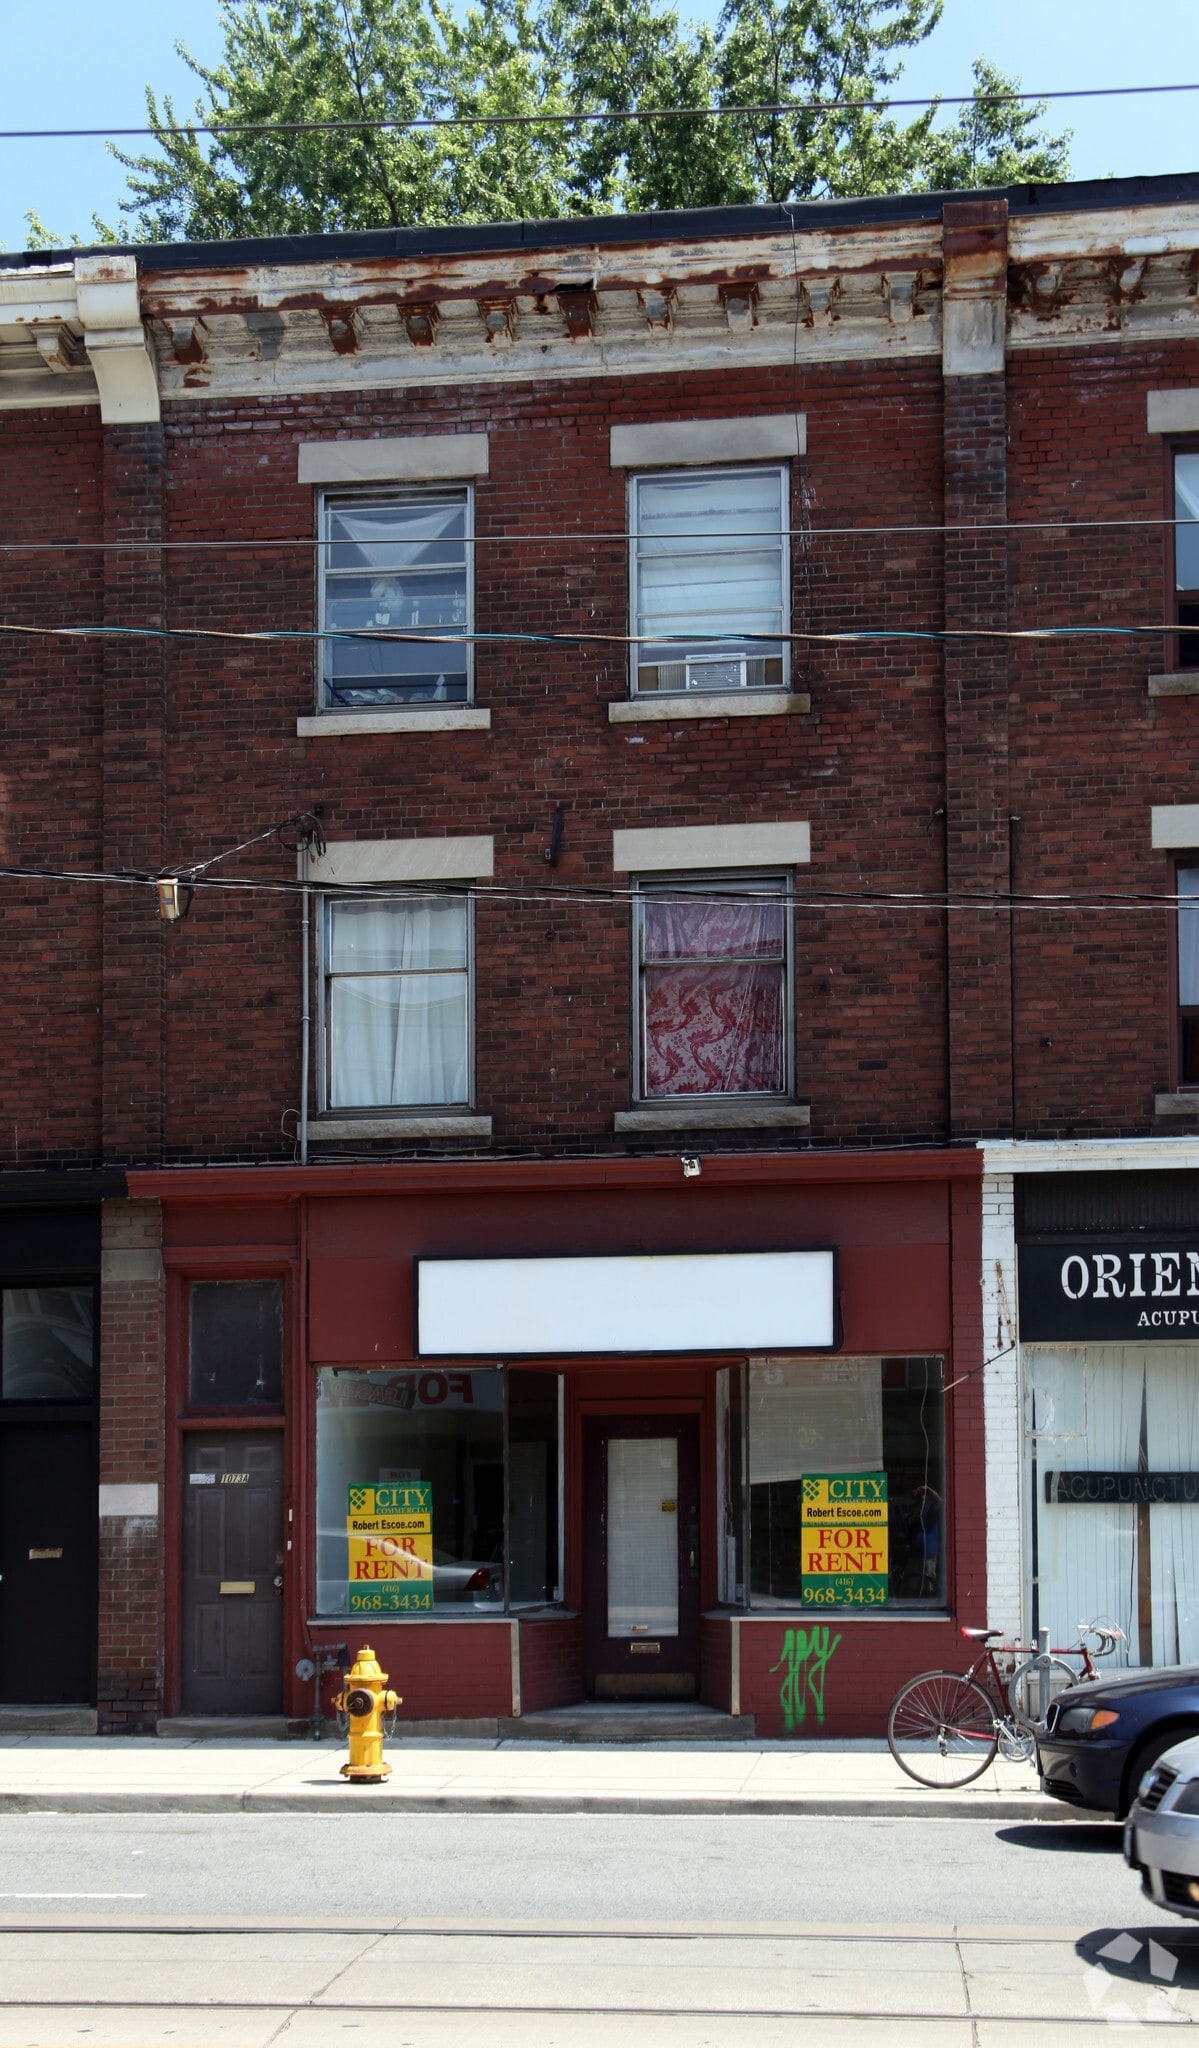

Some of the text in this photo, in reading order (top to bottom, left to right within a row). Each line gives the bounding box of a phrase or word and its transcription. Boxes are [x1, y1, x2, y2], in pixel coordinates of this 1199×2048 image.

[222, 1474, 248, 1483] 1073A
[829, 1479, 885, 1498] CITY
[375, 1488, 430, 1507] CITY
[376, 1507, 428, 1515] COMMERCIAL
[807, 1507, 882, 1517] Robert Escoe.com
[352, 1520, 425, 1530] Robert Escoe.com
[365, 1536, 418, 1557] FOR
[818, 1528, 872, 1549] FOR
[354, 1559, 428, 1579] RENT
[808, 1552, 883, 1572] RENT
[381, 1585, 400, 1594] (416)
[835, 1577, 854, 1587] (416)
[351, 1594, 431, 1611] 968-3434
[803, 1587, 886, 1604] 968-3434
